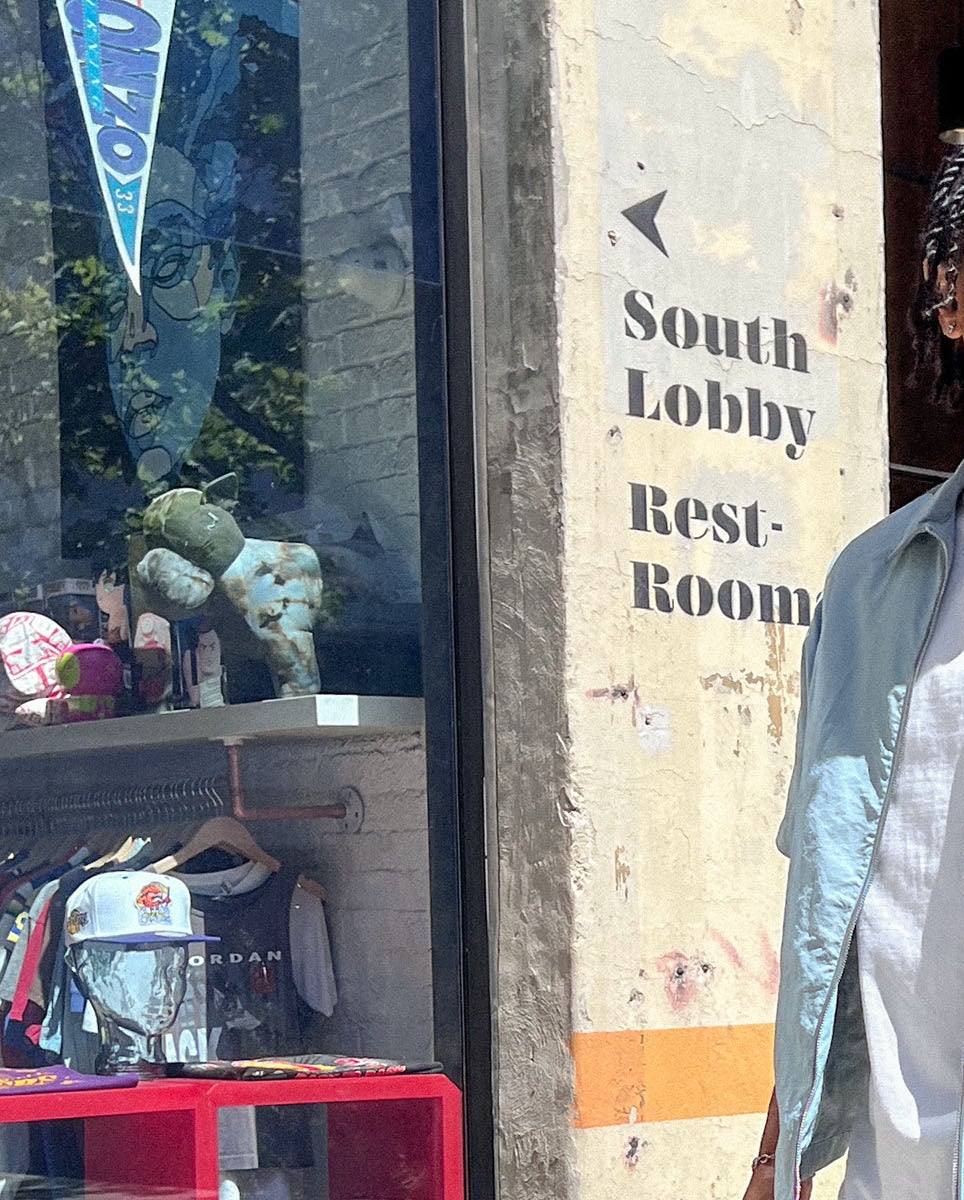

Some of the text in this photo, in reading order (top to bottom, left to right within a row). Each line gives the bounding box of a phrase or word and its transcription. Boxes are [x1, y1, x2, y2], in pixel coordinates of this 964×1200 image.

[115, 188, 134, 214] 33
[624, 289, 810, 374] South
[624, 367, 816, 460] Lobby
[628, 482, 782, 548] Rest-
[630, 560, 822, 626] Room
[188, 950, 282, 967] ORDAN
